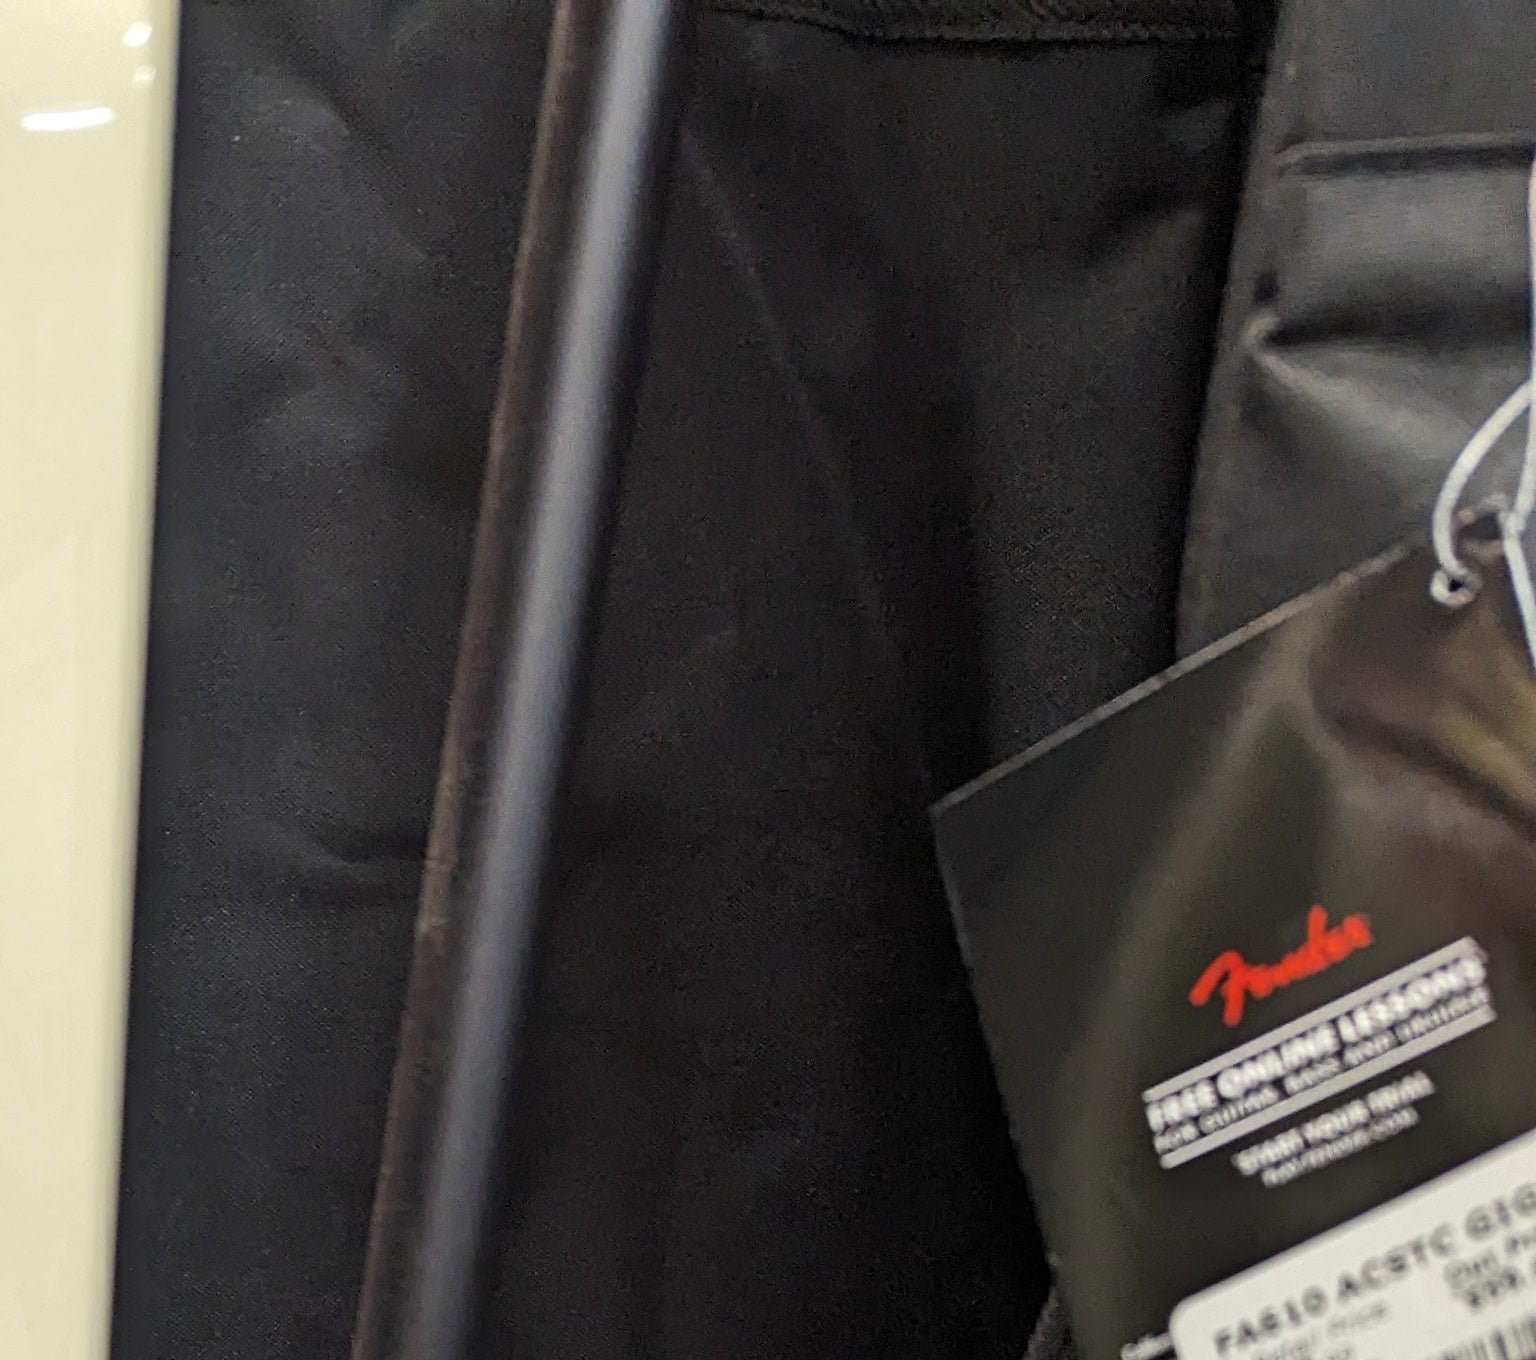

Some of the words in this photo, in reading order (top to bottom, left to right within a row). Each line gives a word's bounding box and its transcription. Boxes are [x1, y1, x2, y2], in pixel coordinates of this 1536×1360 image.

[1189, 903, 1373, 1028] Fender
[1145, 1077, 1219, 1134] FREE
[1216, 1021, 1340, 1100] ONLINE
[1337, 958, 1486, 1044] LESSONS
